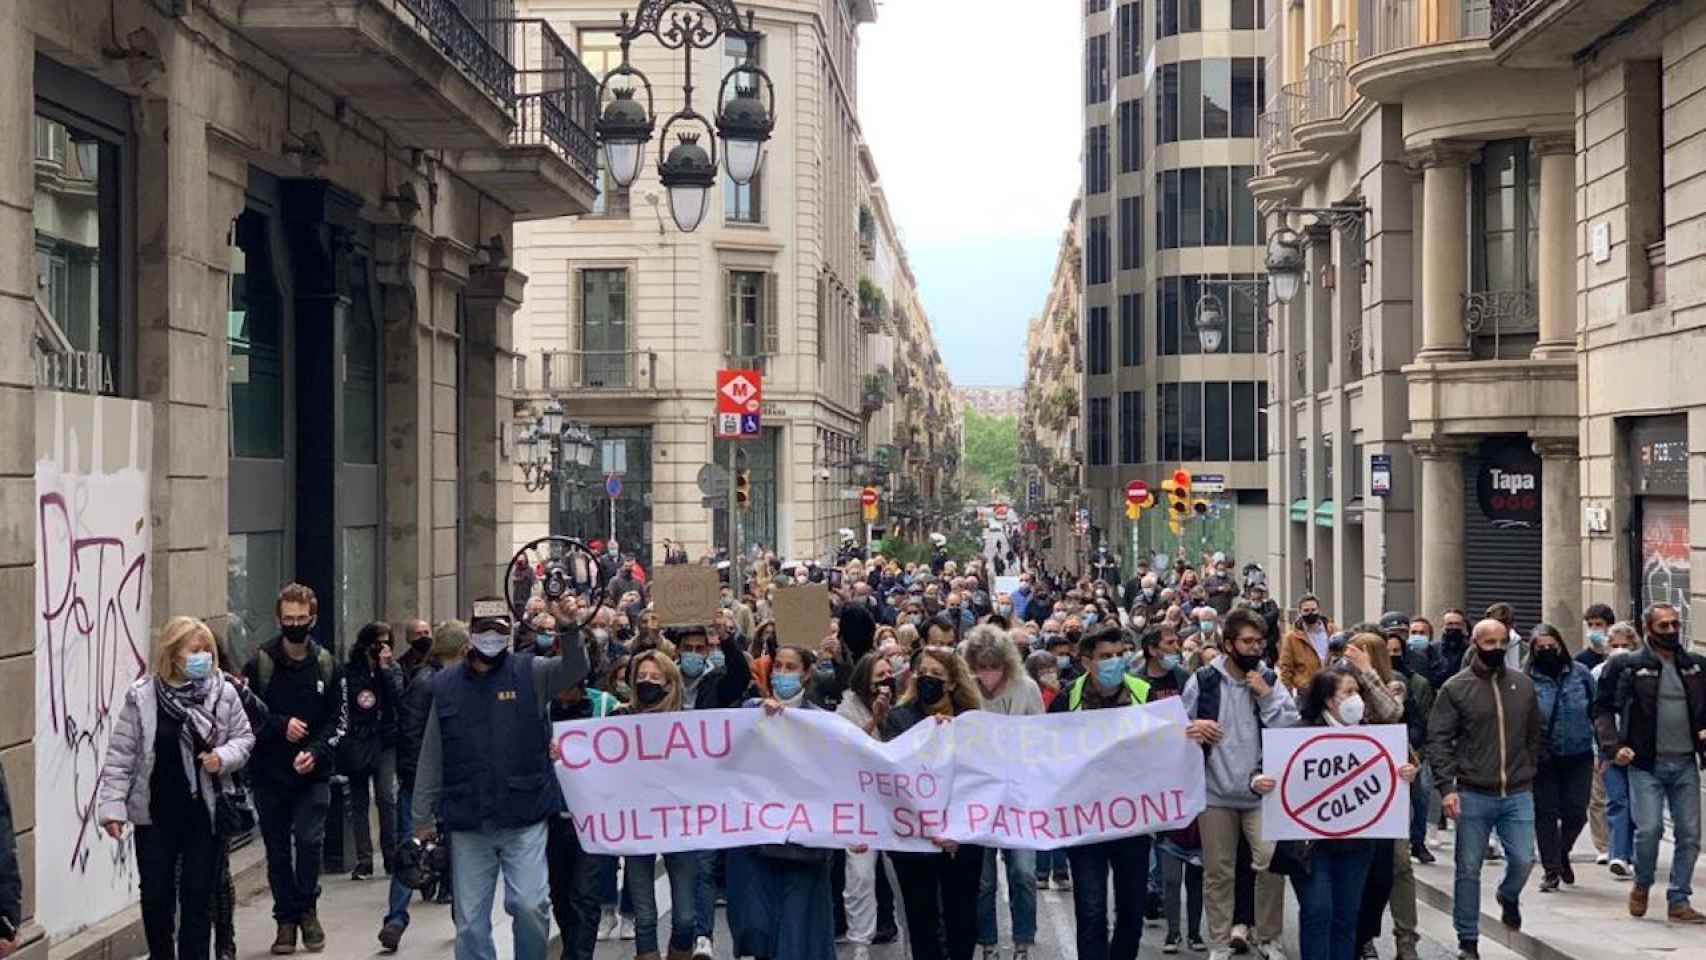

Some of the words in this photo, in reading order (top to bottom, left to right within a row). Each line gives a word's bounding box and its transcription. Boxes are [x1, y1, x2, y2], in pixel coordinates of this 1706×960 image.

[733, 384, 748, 396] M
[1489, 468, 1535, 495] Tapa
[557, 719, 732, 769] COLAU
[858, 764, 936, 799] PERÒ
[1303, 752, 1361, 781] FORA
[1317, 774, 1382, 822] COLAU
[571, 802, 813, 843] MULTIPLICA
[832, 803, 878, 836] EL
[967, 790, 1186, 840] PATRIMONI
